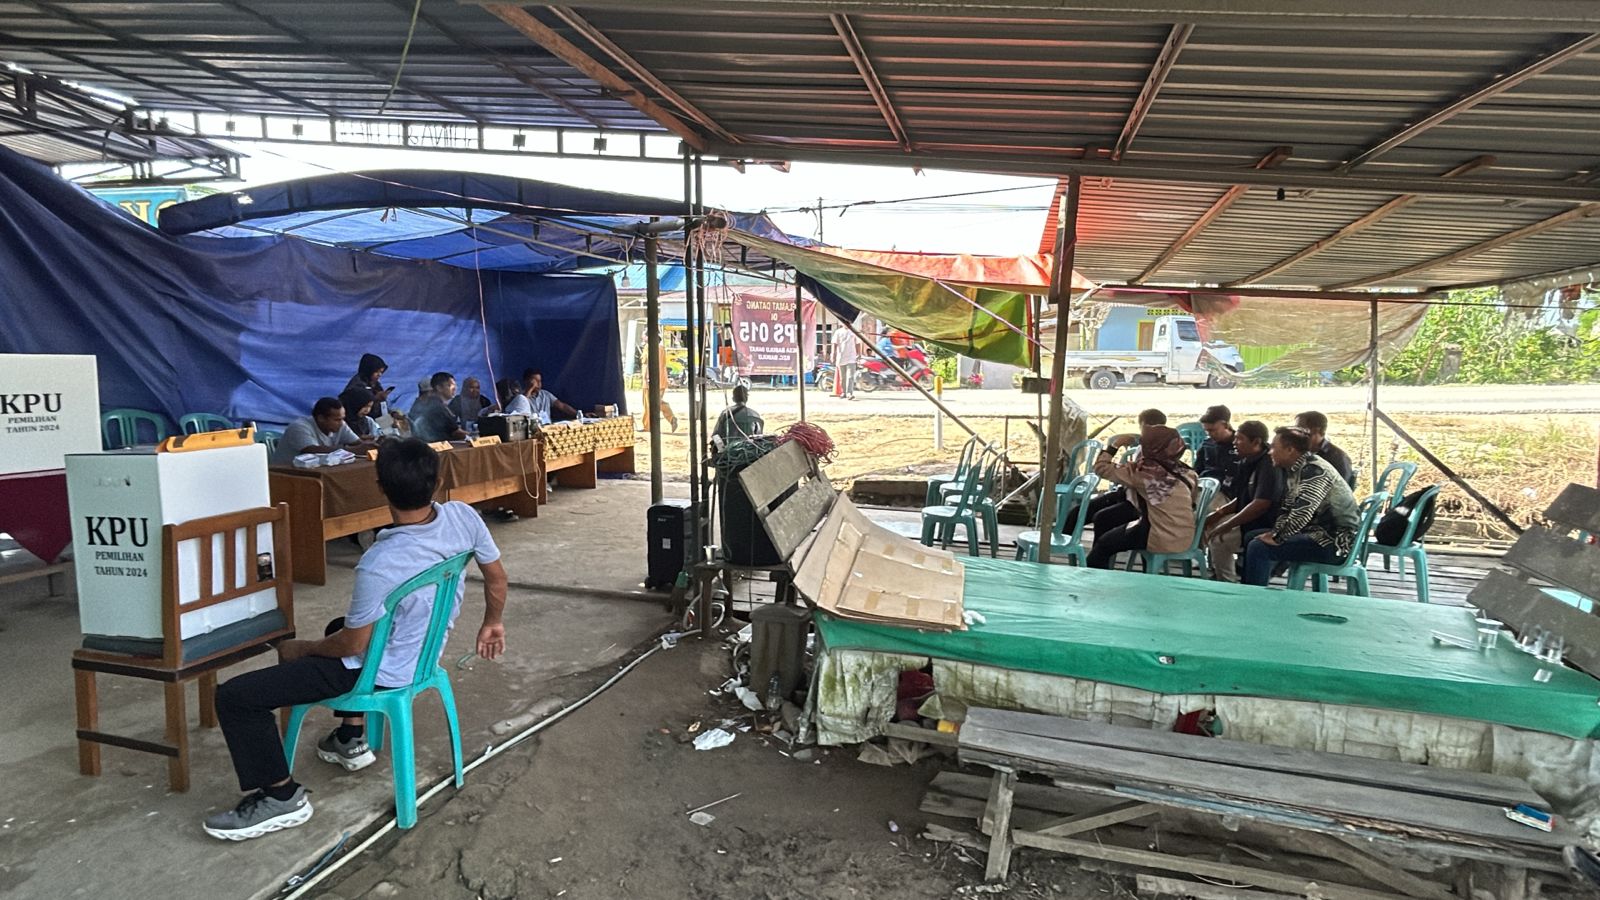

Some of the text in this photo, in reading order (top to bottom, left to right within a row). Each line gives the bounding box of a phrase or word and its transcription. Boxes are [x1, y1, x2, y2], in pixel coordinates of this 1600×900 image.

[0, 393, 62, 414] KPU
[8, 416, 57, 424] PEMILIHAN
[39, 424, 60, 432] 2024
[85, 516, 149, 547] KPU
[95, 551, 144, 562] PEMILIHAN
[94, 566, 148, 577] TAHUN 2024
